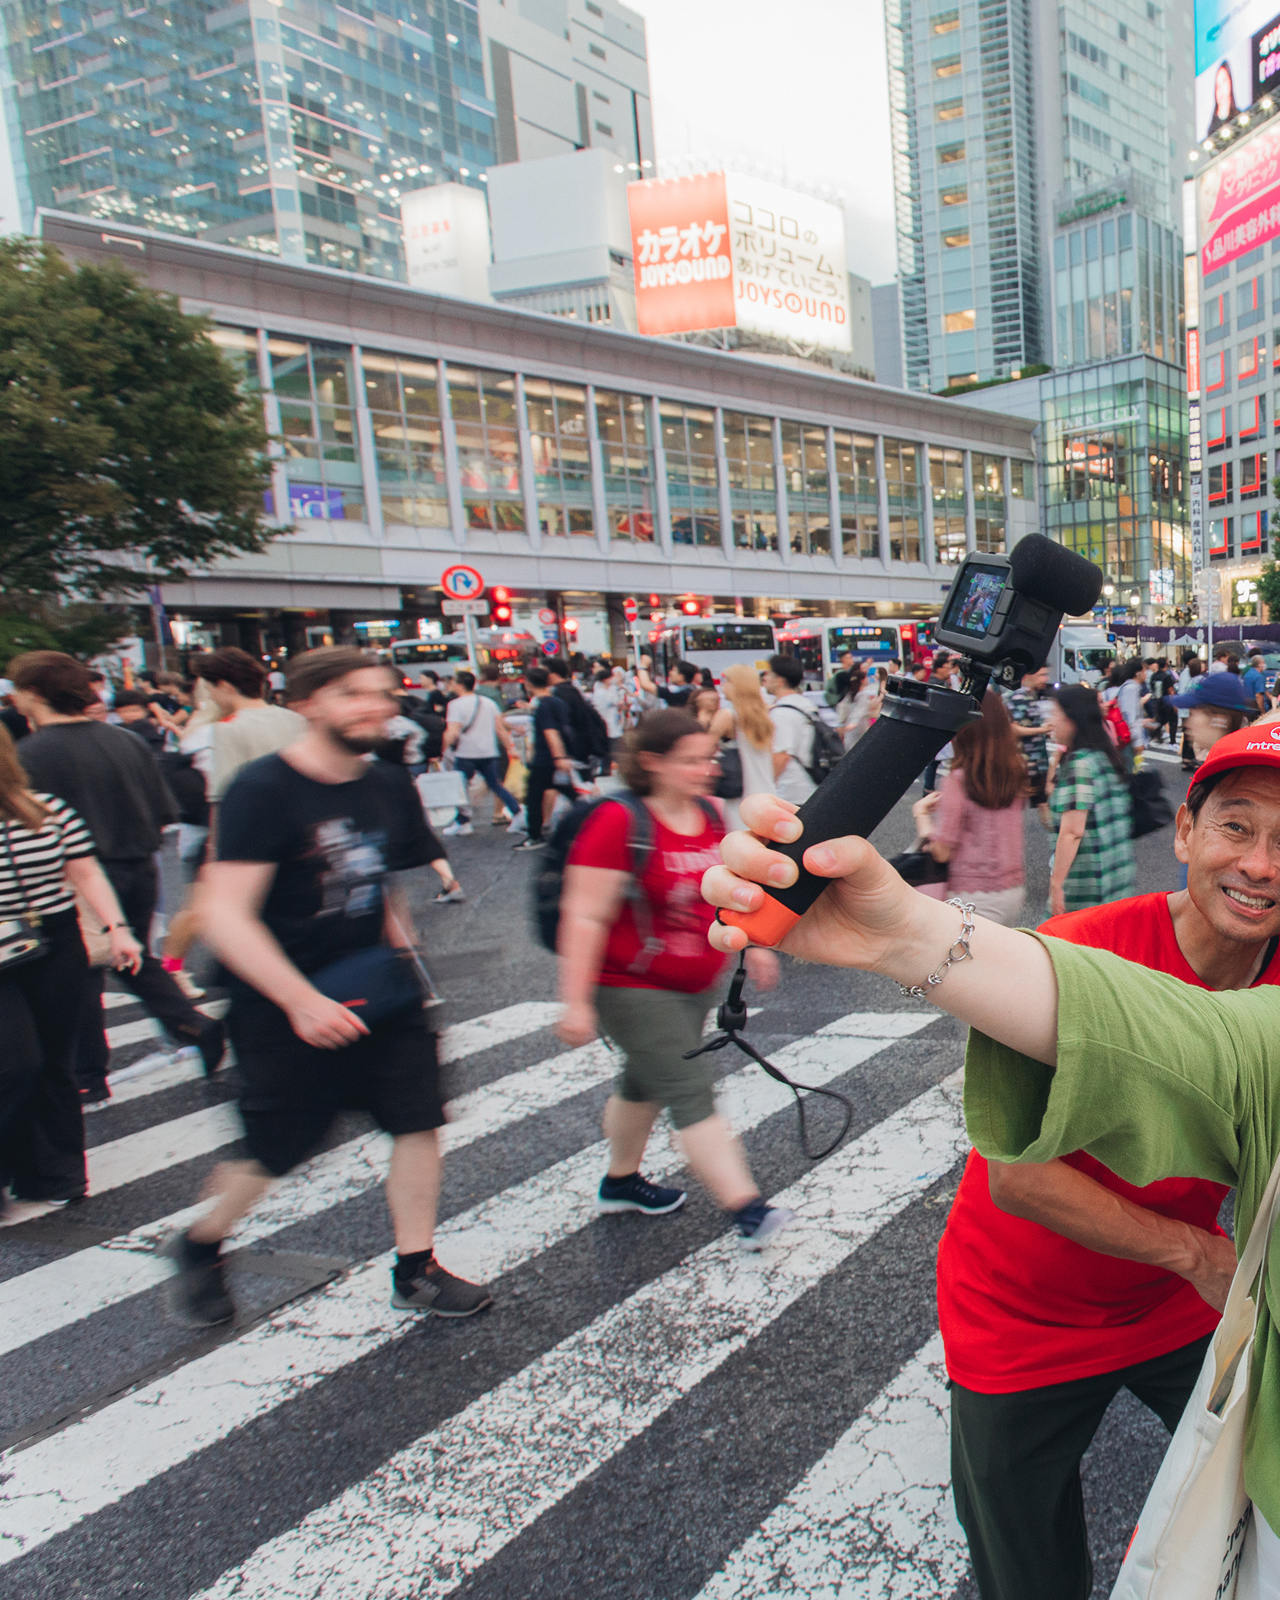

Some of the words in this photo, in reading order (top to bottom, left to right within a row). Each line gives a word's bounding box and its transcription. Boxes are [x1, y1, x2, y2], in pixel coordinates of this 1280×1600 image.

[637, 220, 727, 265] カラオケ
[733, 199, 819, 246] ココロの
[639, 254, 731, 289] JOYSOUND
[735, 229, 844, 281] ボリューム、
[737, 256, 847, 301] あげていこう。
[738, 280, 846, 325] JOYSOUND
[1102, 403, 1140, 421] CITY
